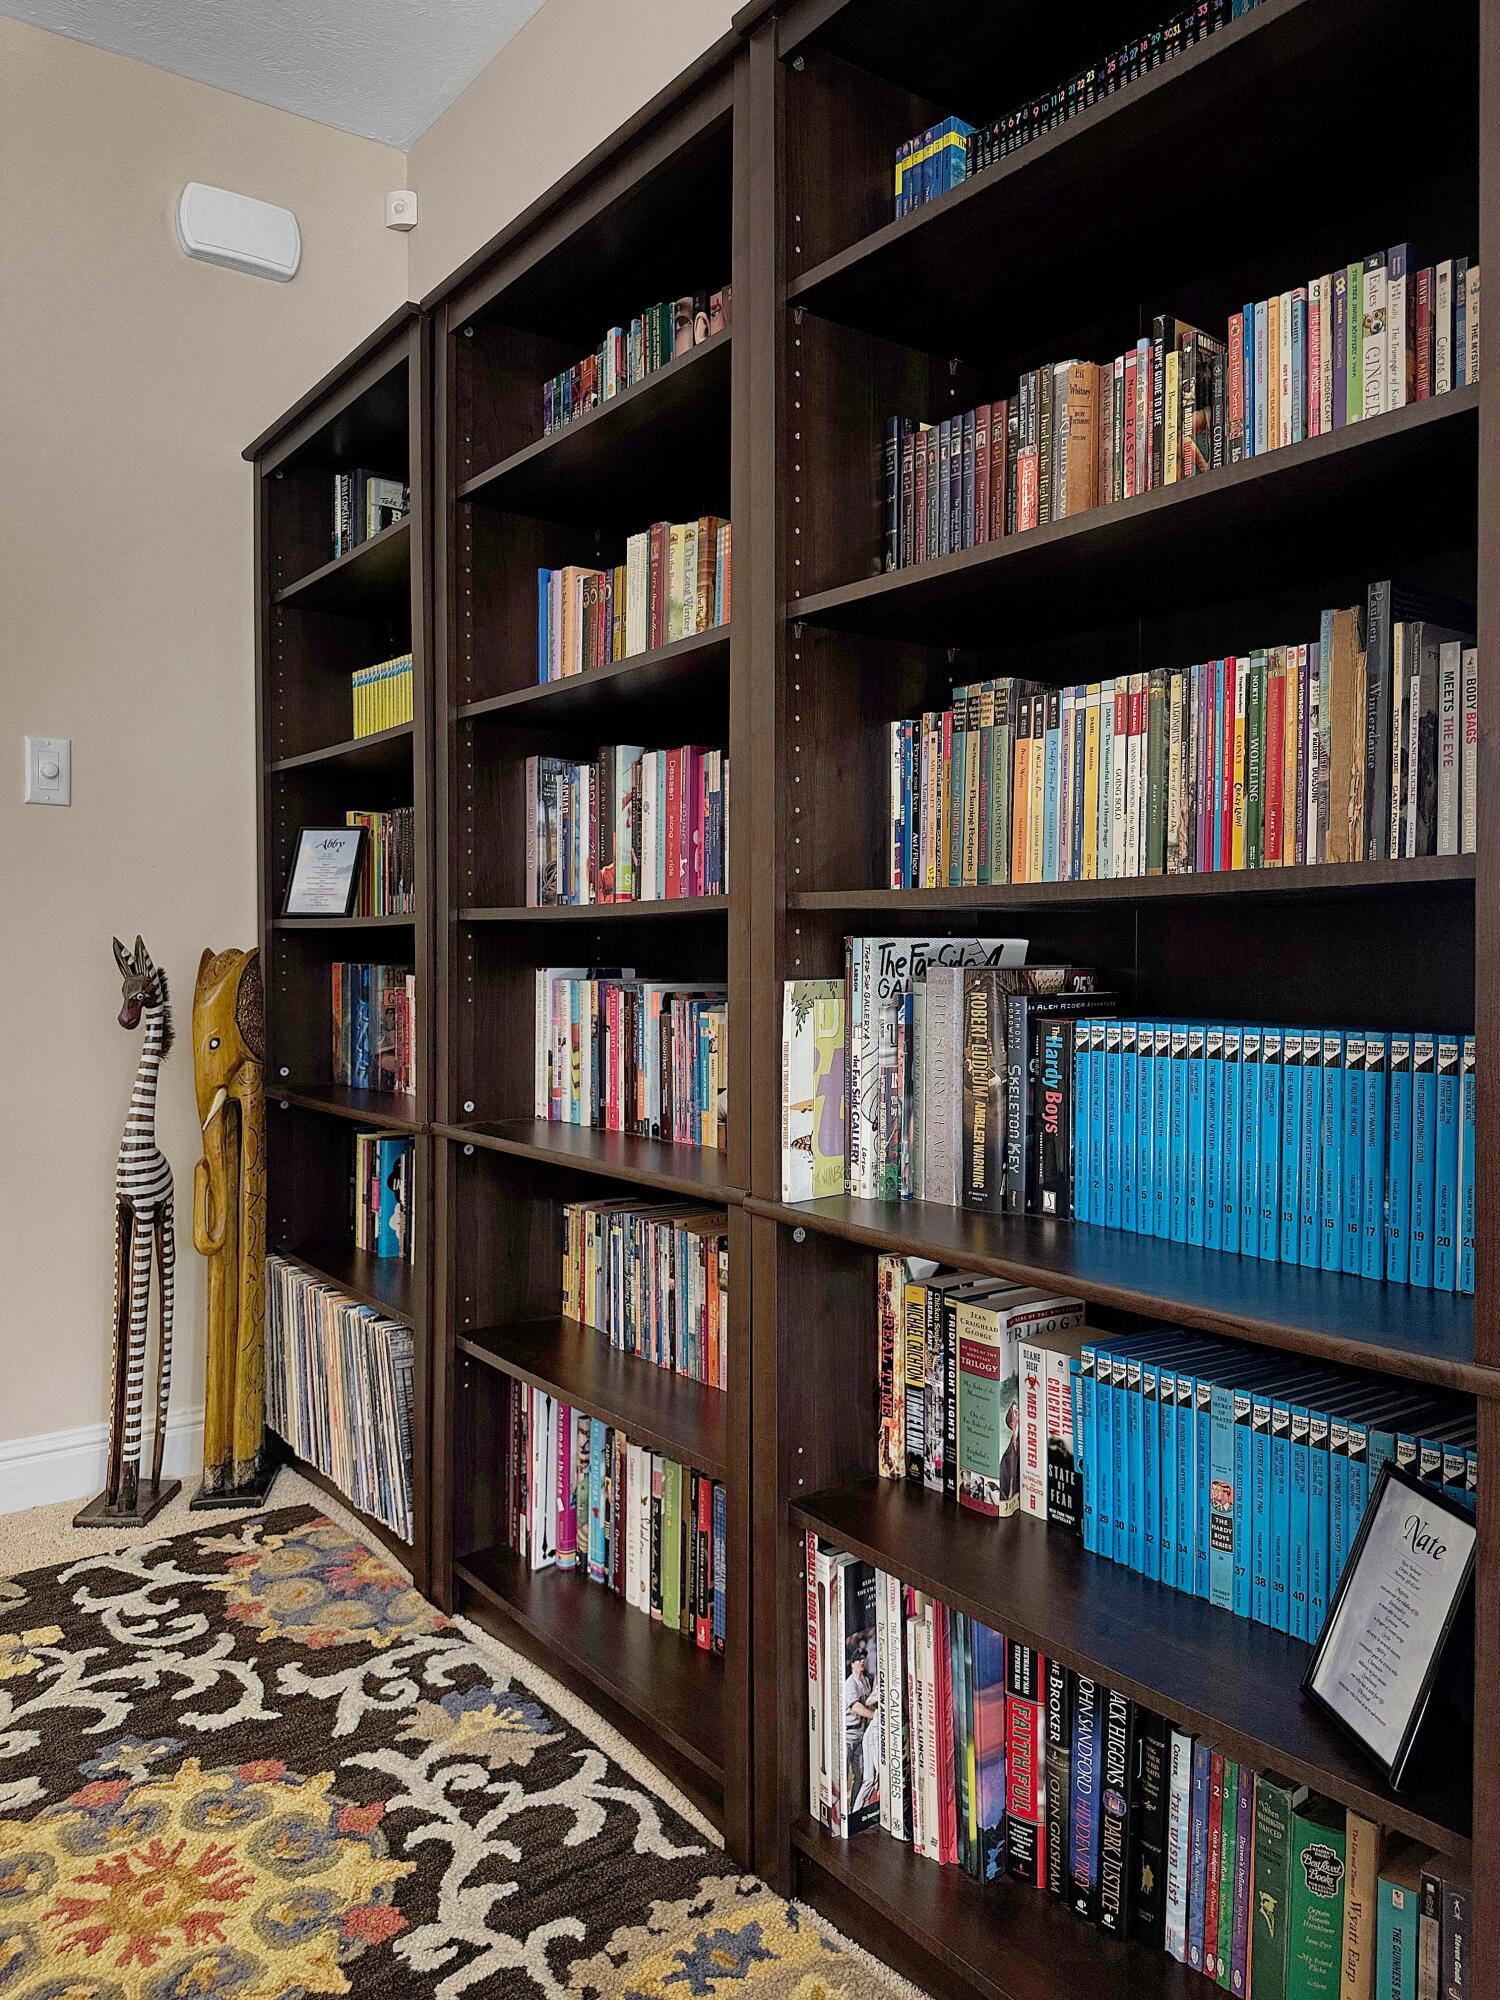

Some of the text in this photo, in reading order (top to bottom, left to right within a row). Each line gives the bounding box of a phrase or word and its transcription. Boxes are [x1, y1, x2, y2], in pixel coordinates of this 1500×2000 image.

[1198, 3, 1208, 17] 33
[1151, 32, 1160, 45] 29
[1164, 28, 1173, 41] 30
[1173, 24, 1181, 36] 31
[1130, 47, 1138, 60] 27
[1107, 60, 1116, 74] 25
[1016, 112, 1021, 124] 7
[1032, 106, 1040, 118] 9
[1313, 285, 1320, 297] 8
[1369, 274, 1381, 307] Estes
[1419, 278, 1427, 305] DAVIS
[1390, 342, 1399, 375] Trumpeter
[1070, 384, 1091, 399] Whitney
[1154, 371, 1162, 392] GUIDE
[1365, 346, 1381, 418] GINGER
[1154, 393, 1162, 402] TO
[1230, 390, 1240, 418] Series
[1041, 413, 1049, 438] Duel
[1040, 452, 1048, 472] the
[380, 498, 397, 506] Take
[1040, 504, 1048, 524] Hill
[683, 545, 695, 636] The Long Winter
[1371, 592, 1383, 644] Paulsen
[1444, 670, 1455, 712] MEETS
[1172, 701, 1180, 744] ALGONQUIN
[1368, 680, 1382, 768] Winterdance
[1443, 715, 1454, 739] THE
[1443, 742, 1453, 768] EYE
[1464, 678, 1476, 854] BODY BAGS christopher golden
[1250, 737, 1259, 802] WOLFLING
[315, 838, 345, 852] Abby
[1442, 818, 1450, 850] golden
[879, 942, 1005, 978] The Far 4
[1073, 976, 1093, 992] 25%
[971, 992, 988, 1039] ROBERT
[971, 1044, 989, 1097] LUDLUM
[1042, 1026, 1062, 1133] The Hardy Boys
[851, 1070, 860, 1166] FAR Side GALLERY
[973, 1100, 986, 1143] AMBLER
[1008, 1065, 1021, 1174] SKELETON KEY
[972, 1143, 985, 1189] WARNING
[1348, 1223, 1358, 1233] 16
[1366, 1227, 1376, 1236] 17
[1390, 1228, 1400, 1238] 18
[1414, 1231, 1424, 1241] 19
[1437, 1236, 1450, 1247] 20
[960, 1317, 998, 1333] CRAIGHEAD
[965, 1327, 992, 1340] GEORGE
[1007, 1314, 1083, 1343] TRILOGY
[907, 1301, 924, 1383] MICHAEL CRICHTON
[881, 1316, 894, 1417] REAL TIME
[961, 1357, 998, 1373] TRILOGY
[1023, 1350, 1041, 1362] DIANE
[1048, 1377, 1060, 1436] CRICHTON
[1062, 1384, 1073, 1439] MICHAEL
[1027, 1392, 1038, 1469] MED CENTER
[1023, 1474, 1043, 1486] VIRUS
[1049, 1464, 1075, 1486] STATE
[665, 1470, 673, 1517] Dessen
[1050, 1489, 1073, 1509] FEAR
[1212, 1524, 1232, 1534] HARDY
[1215, 1517, 1228, 1525] THE
[1212, 1540, 1232, 1550] SERIES
[1214, 1532, 1229, 1542] BOYS
[1402, 1514, 1447, 1560] Nate
[1235, 1566, 1245, 1576] 37
[1255, 1576, 1266, 1587] 38
[1273, 1582, 1285, 1592] 39
[1293, 1591, 1304, 1602] 40
[1312, 1596, 1322, 1608] 41
[808, 1594, 817, 1681] BOOK OF FIRSTS
[1050, 1676, 1063, 1741] BROKER
[890, 1688, 901, 1799] CALVIN HOBBES
[1012, 1703, 1031, 1812] FAITHFUL
[1076, 1673, 1094, 1855] JOHN SANDFORD HIDDEN
[1102, 1690, 1129, 1914] JACK HIGGINS DARK JUSTICE
[1049, 1771, 1061, 1893] JOHN GRISHAM
[1259, 1822, 1282, 1839] DANCED
[1350, 1902, 1362, 1945] Wyatt
[1345, 1948, 1360, 1982] Earp
[1392, 1928, 1402, 1983] THE GUINNESS
